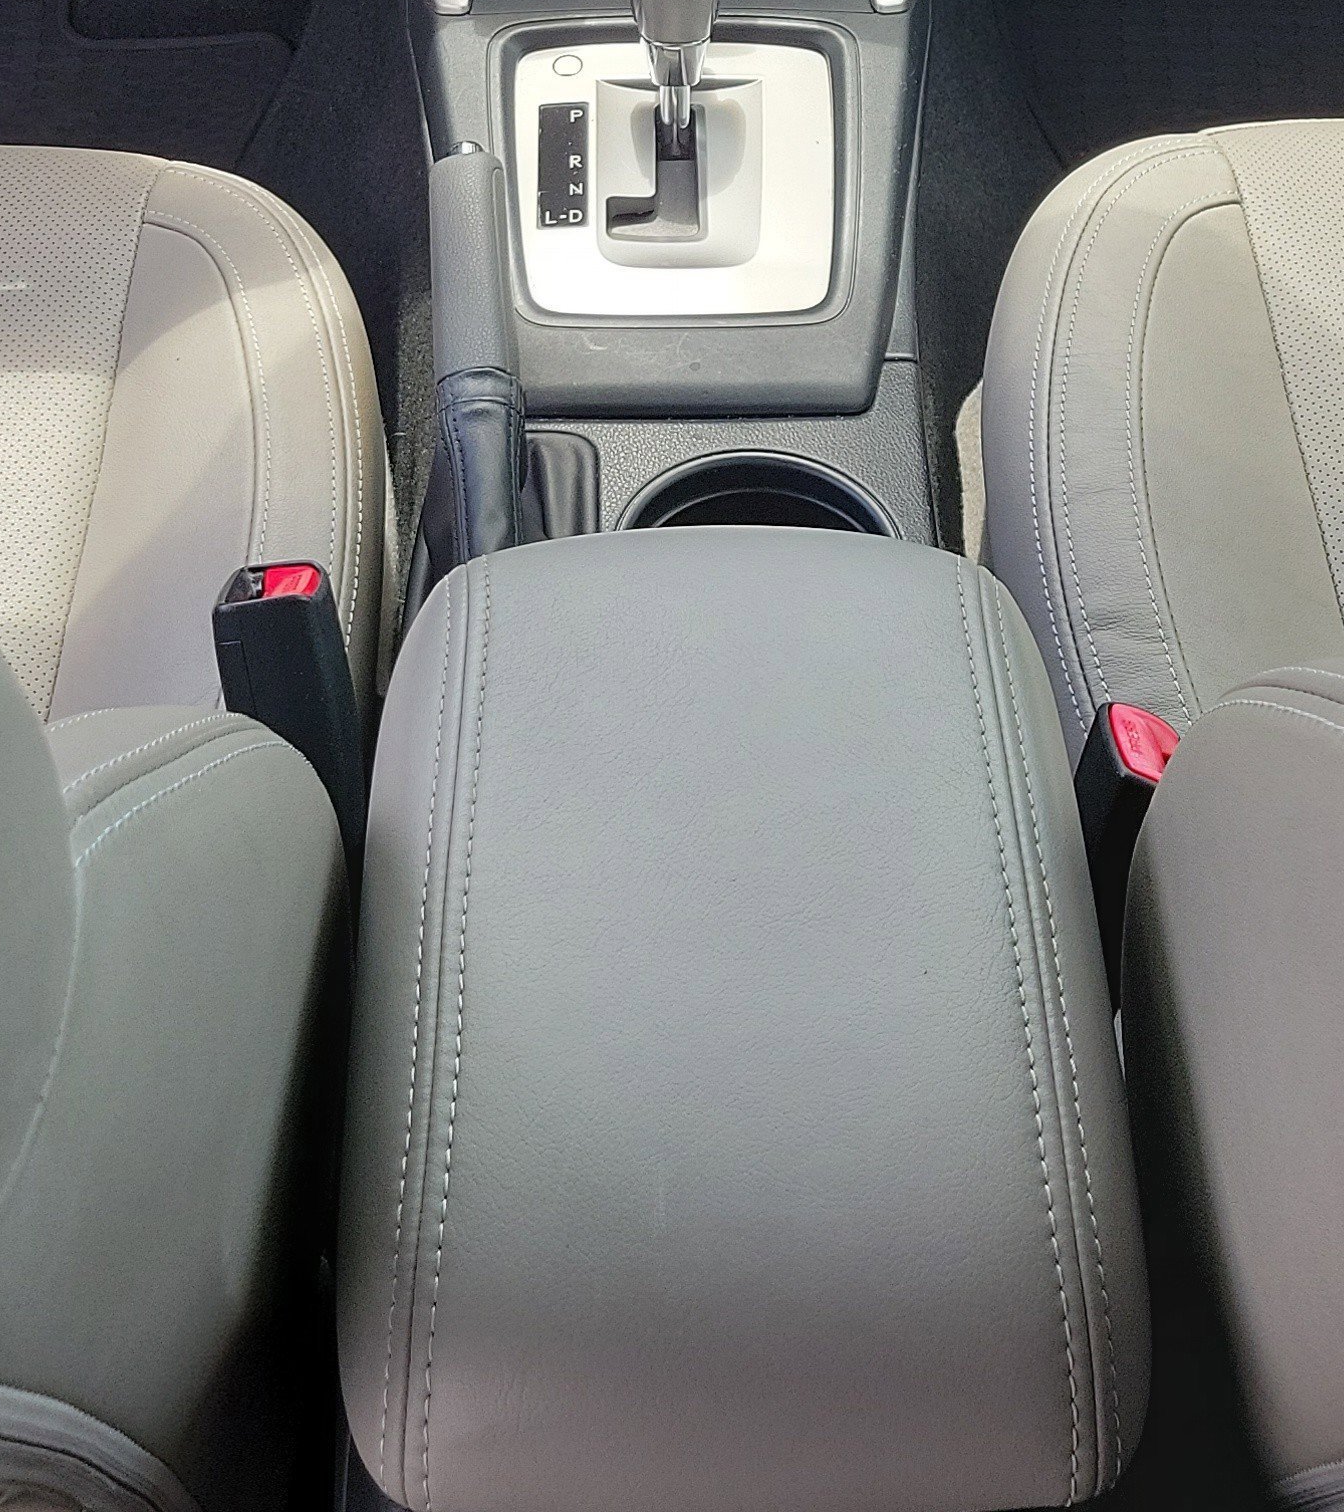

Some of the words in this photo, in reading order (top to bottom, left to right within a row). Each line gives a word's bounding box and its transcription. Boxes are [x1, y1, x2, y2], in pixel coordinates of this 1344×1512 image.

[569, 109, 584, 123] P
[568, 154, 583, 169] R
[569, 182, 584, 196] N
